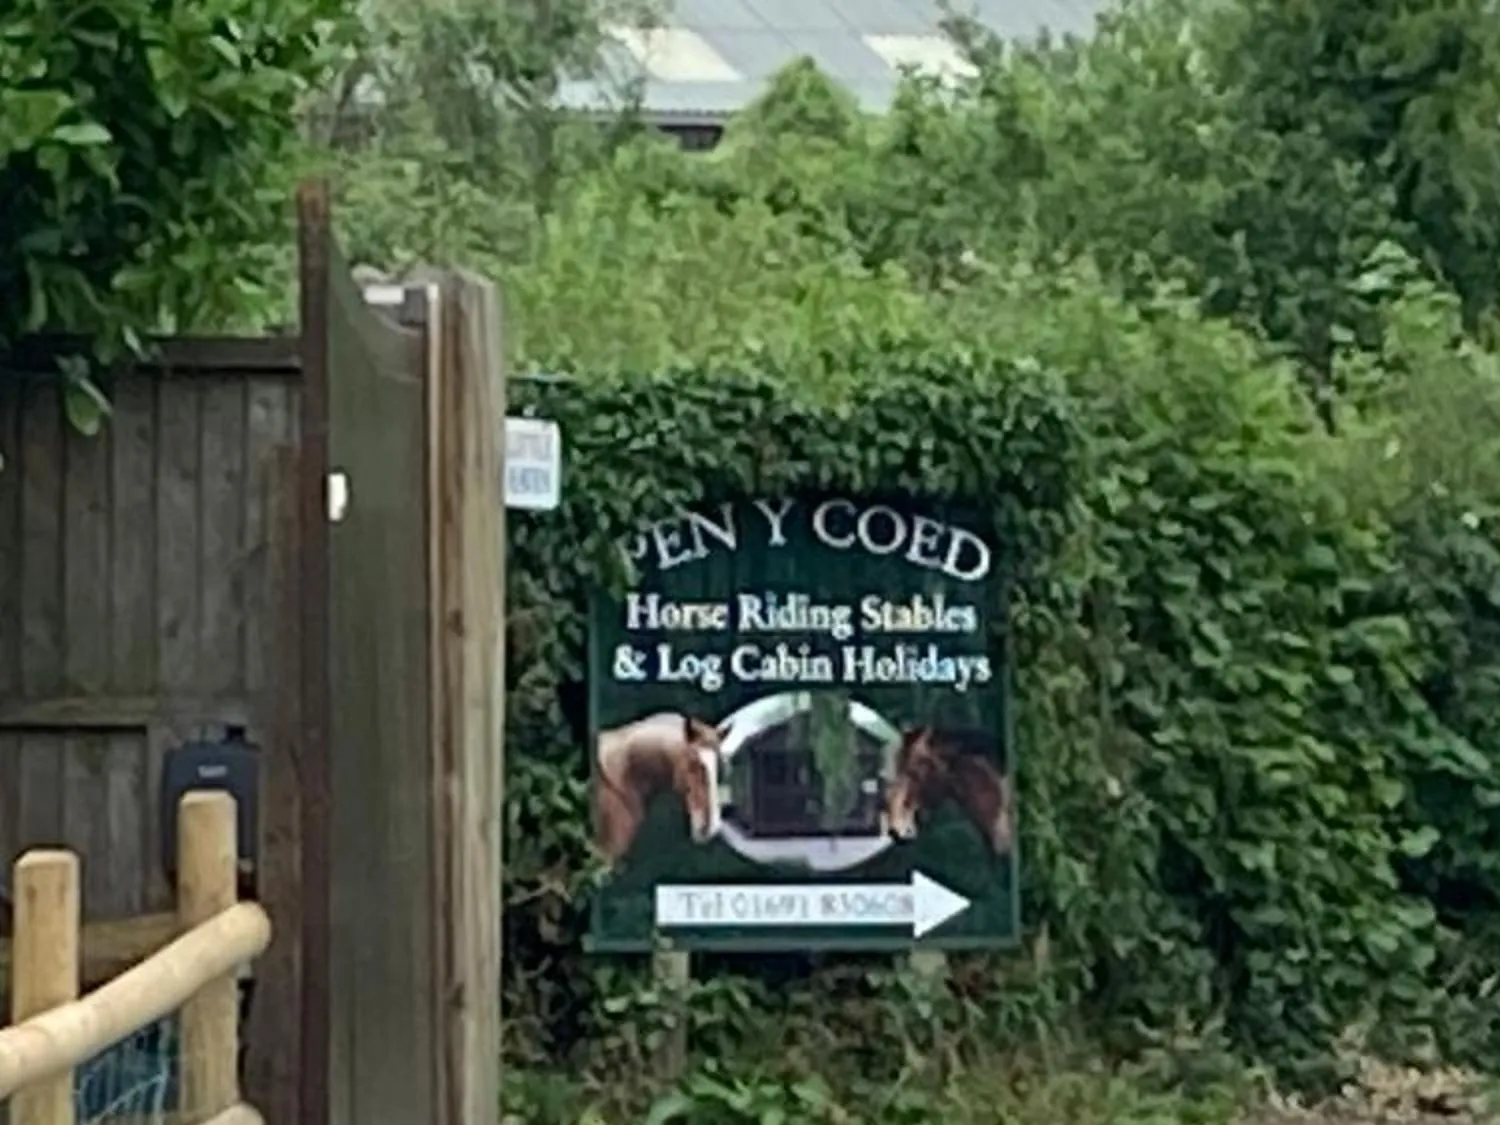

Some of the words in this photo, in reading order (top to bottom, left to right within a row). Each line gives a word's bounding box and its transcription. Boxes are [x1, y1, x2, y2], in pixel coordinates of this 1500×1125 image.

[752, 499, 793, 548] Y
[812, 499, 991, 582] COED
[625, 592, 729, 630] Horse
[737, 592, 855, 641] Riding
[860, 593, 977, 633] Stables
[612, 644, 648, 680] &
[656, 645, 723, 692] Log
[731, 643, 834, 683] Cabin
[841, 643, 993, 692] Holidays
